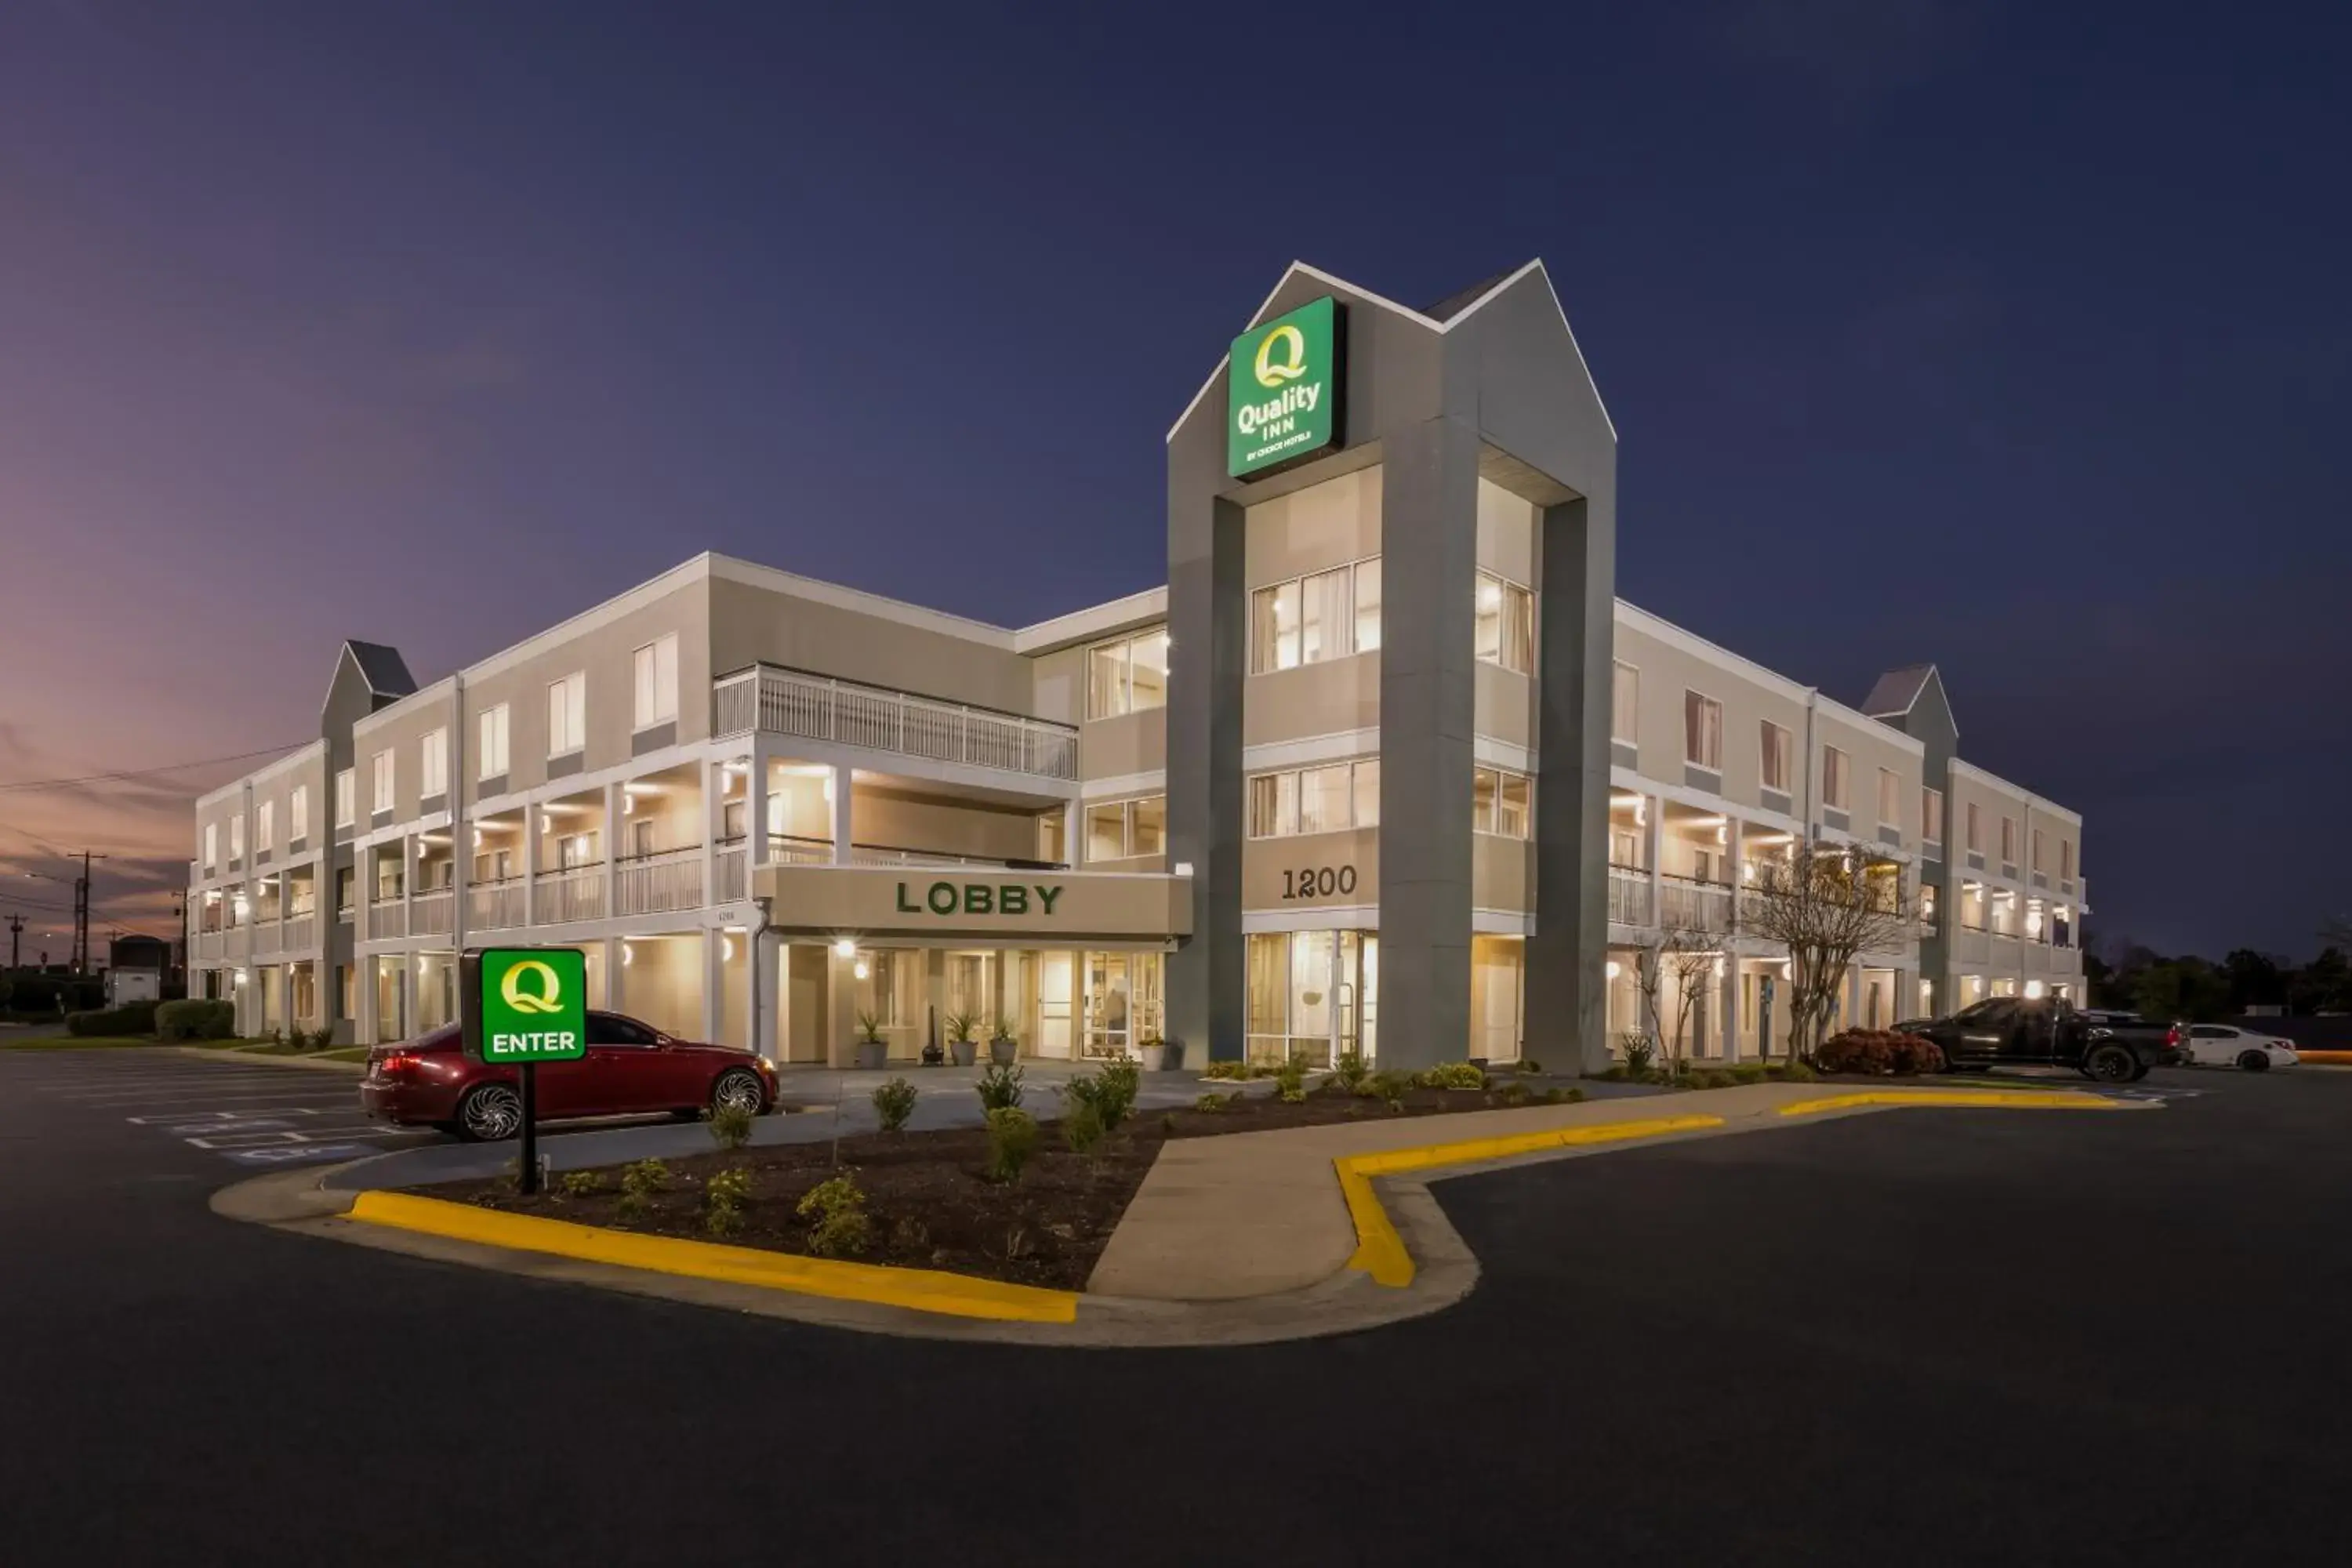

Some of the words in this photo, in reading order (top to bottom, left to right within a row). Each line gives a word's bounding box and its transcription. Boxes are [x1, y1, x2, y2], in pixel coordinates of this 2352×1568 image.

[1255, 325, 1307, 387] Q
[1238, 382, 1321, 434] Quality
[1263, 416, 1294, 441] INN
[897, 881, 1063, 915] LOBBY
[1282, 865, 1357, 899] 1200
[501, 960, 564, 1014] Q
[492, 1031, 576, 1054] ENTER
